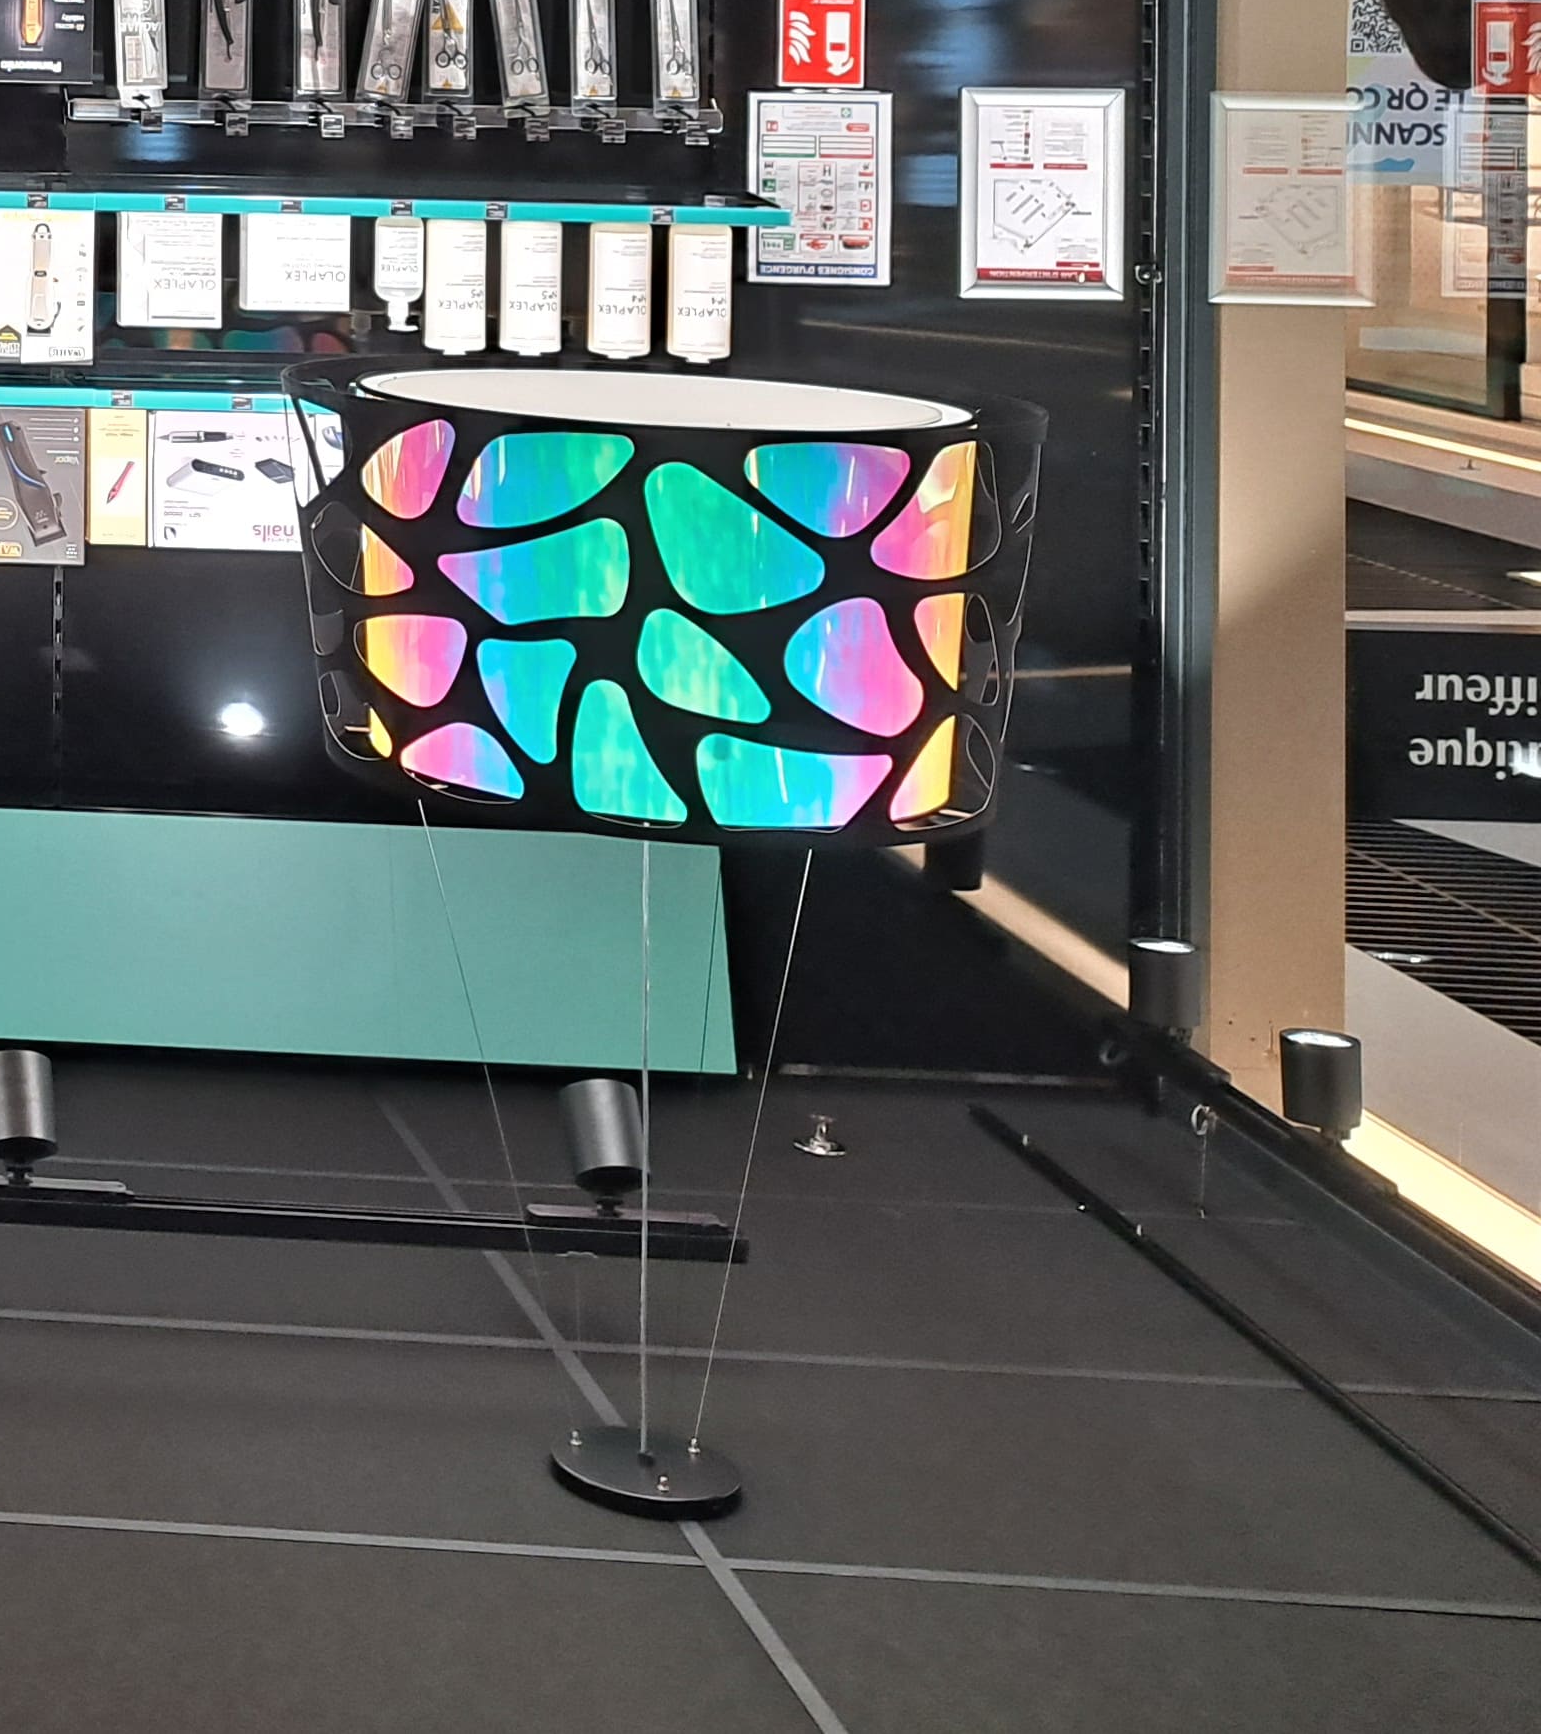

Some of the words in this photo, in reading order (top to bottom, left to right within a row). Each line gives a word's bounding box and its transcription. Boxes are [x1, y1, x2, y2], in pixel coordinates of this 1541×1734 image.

[0, 60, 62, 73] Panasonic
[1387, 82, 1428, 111] QR
[760, 265, 815, 274] D'URGENCE
[818, 266, 874, 275] CONSIGNES
[285, 269, 346, 282] OLAPLEX
[154, 277, 216, 290] OLAPLEX
[438, 299, 485, 310] OLAPLEX
[509, 301, 557, 312] OLAPLEX
[598, 304, 647, 315] OLAPLEX
[677, 306, 726, 317] OLAPLEX
[253, 525, 294, 542] nails
